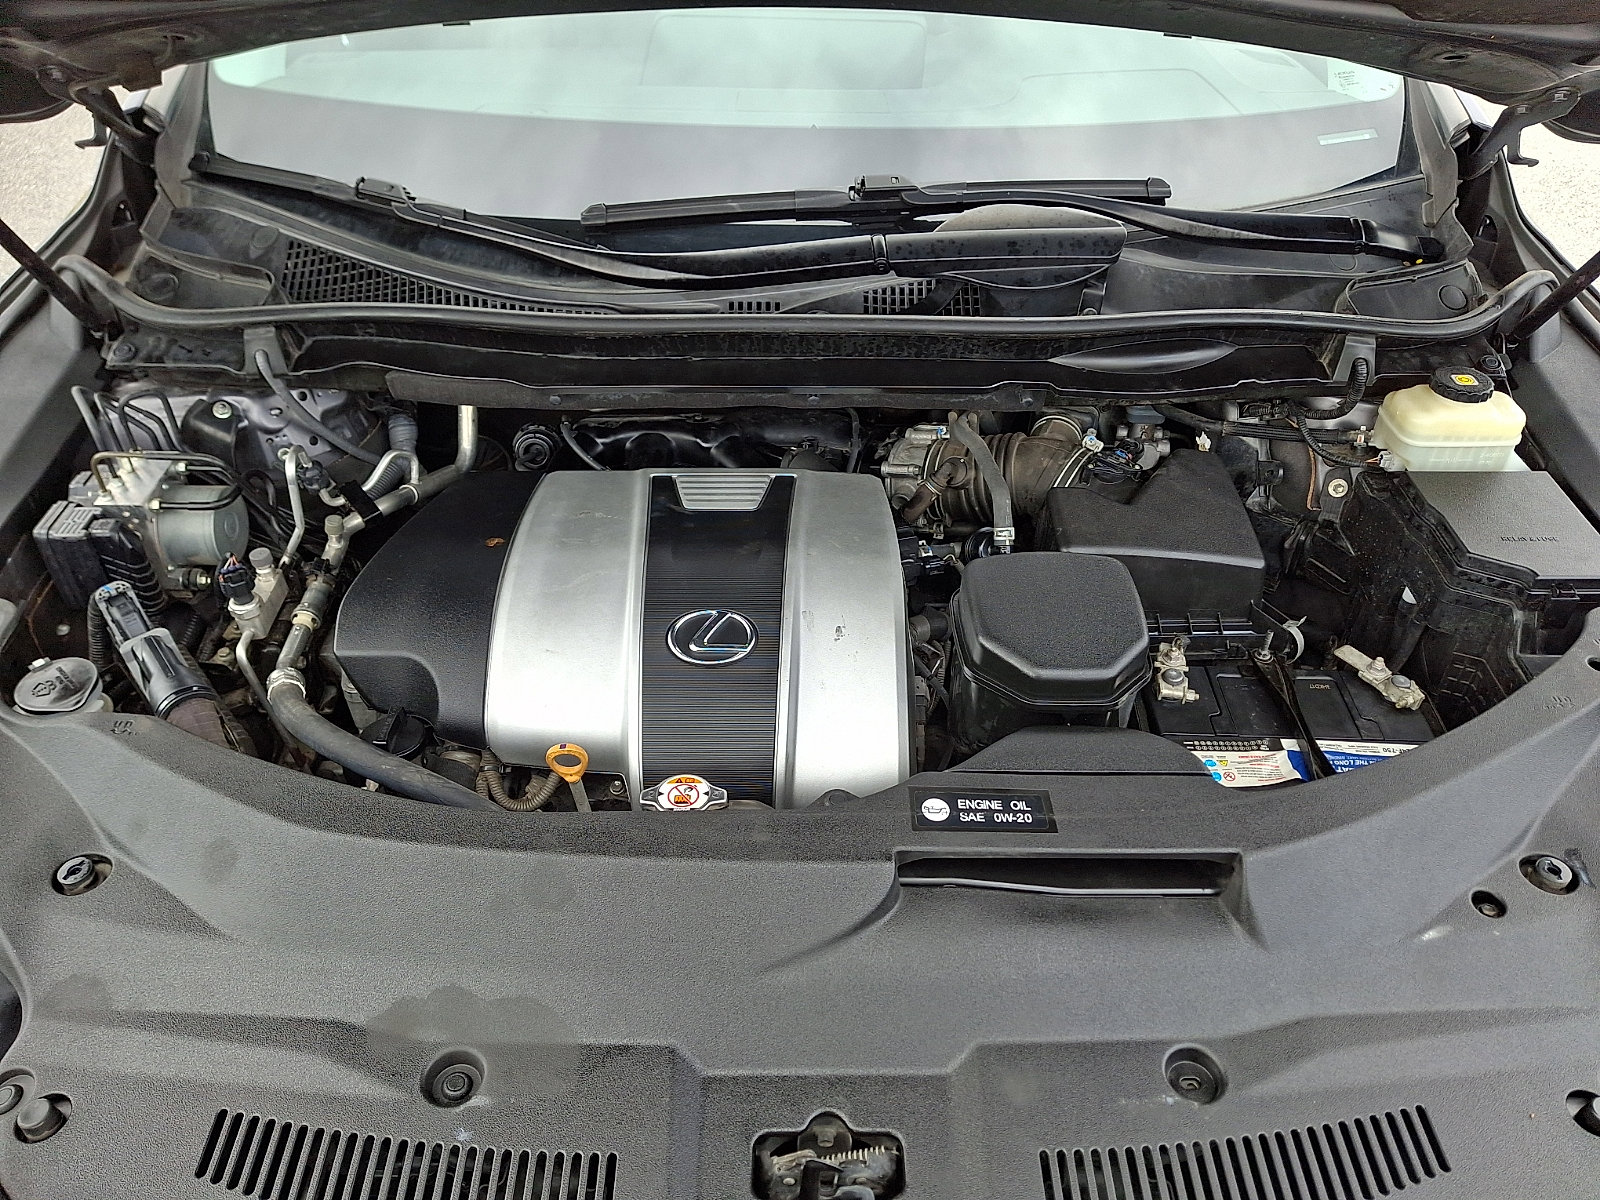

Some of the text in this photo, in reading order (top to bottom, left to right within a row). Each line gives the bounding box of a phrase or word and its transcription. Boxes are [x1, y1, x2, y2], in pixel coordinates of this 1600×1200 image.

[957, 799, 1032, 811] ENGINE OIL
[959, 812, 1033, 824] SAE 0W-20
